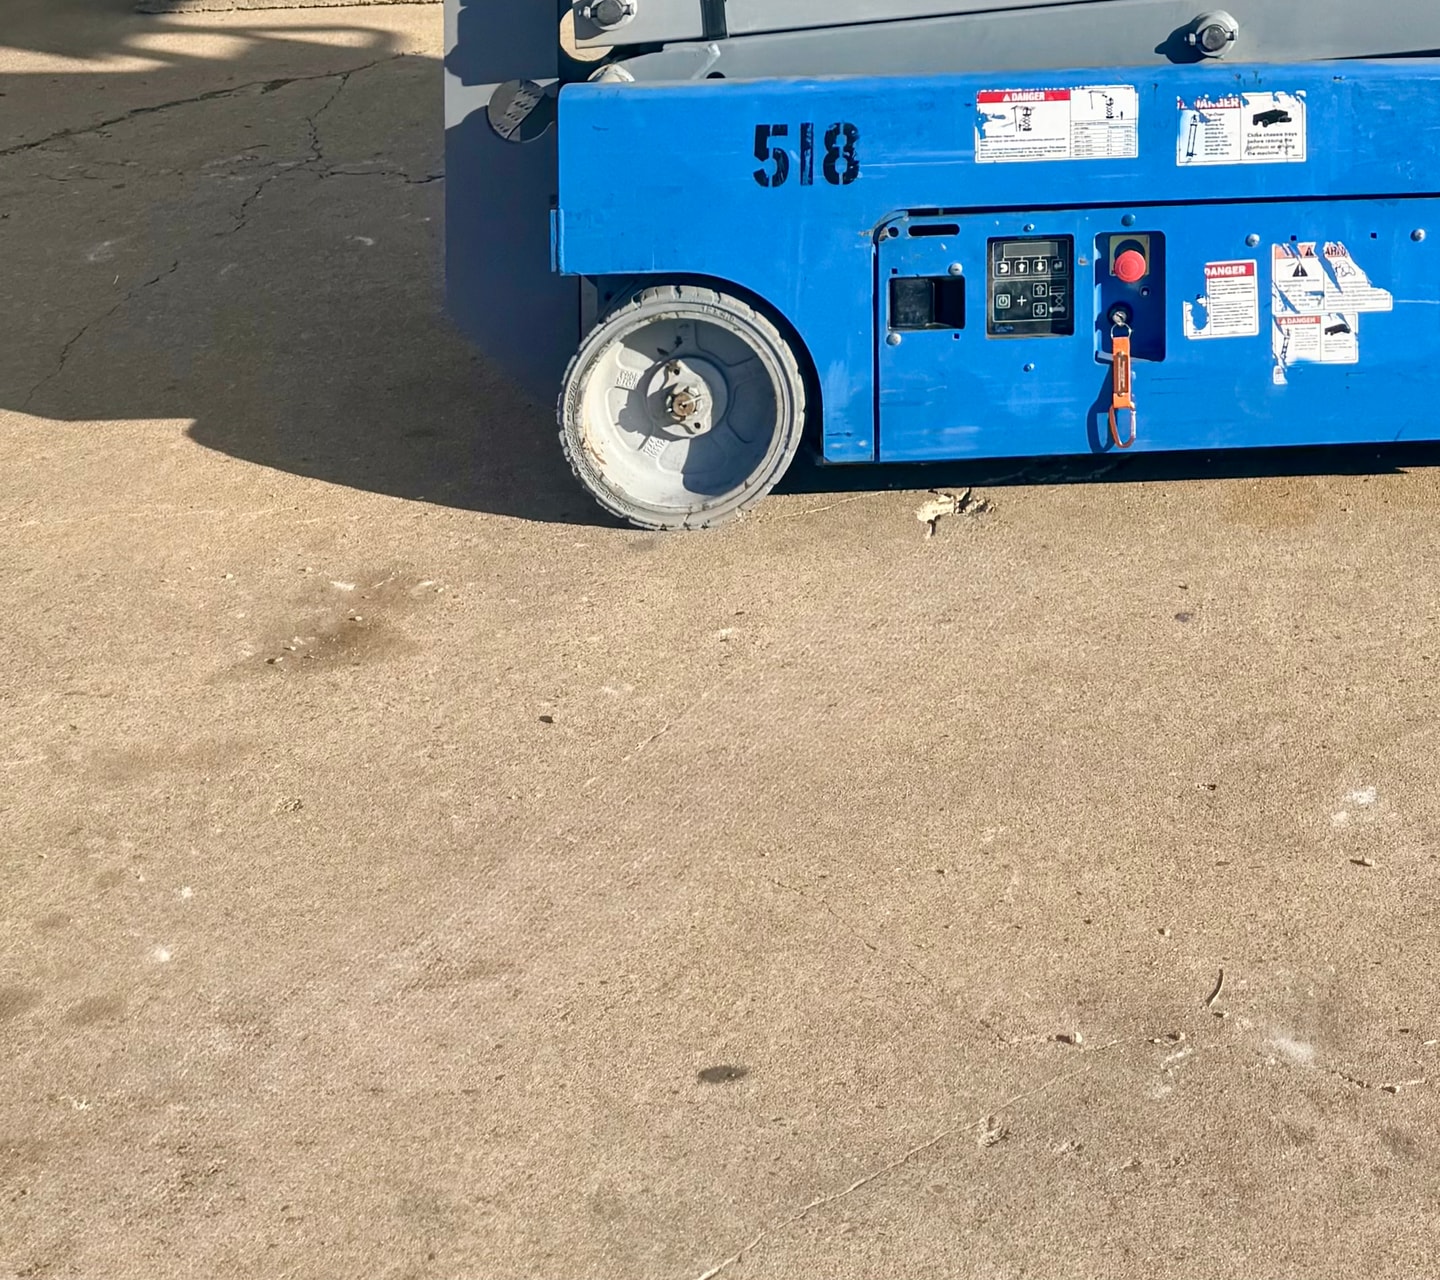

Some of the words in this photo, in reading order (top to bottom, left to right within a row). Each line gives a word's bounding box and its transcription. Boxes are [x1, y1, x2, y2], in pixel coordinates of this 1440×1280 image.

[1011, 91, 1046, 102] DANGER
[753, 122, 860, 188] 518
[1204, 265, 1247, 277] DANGER
